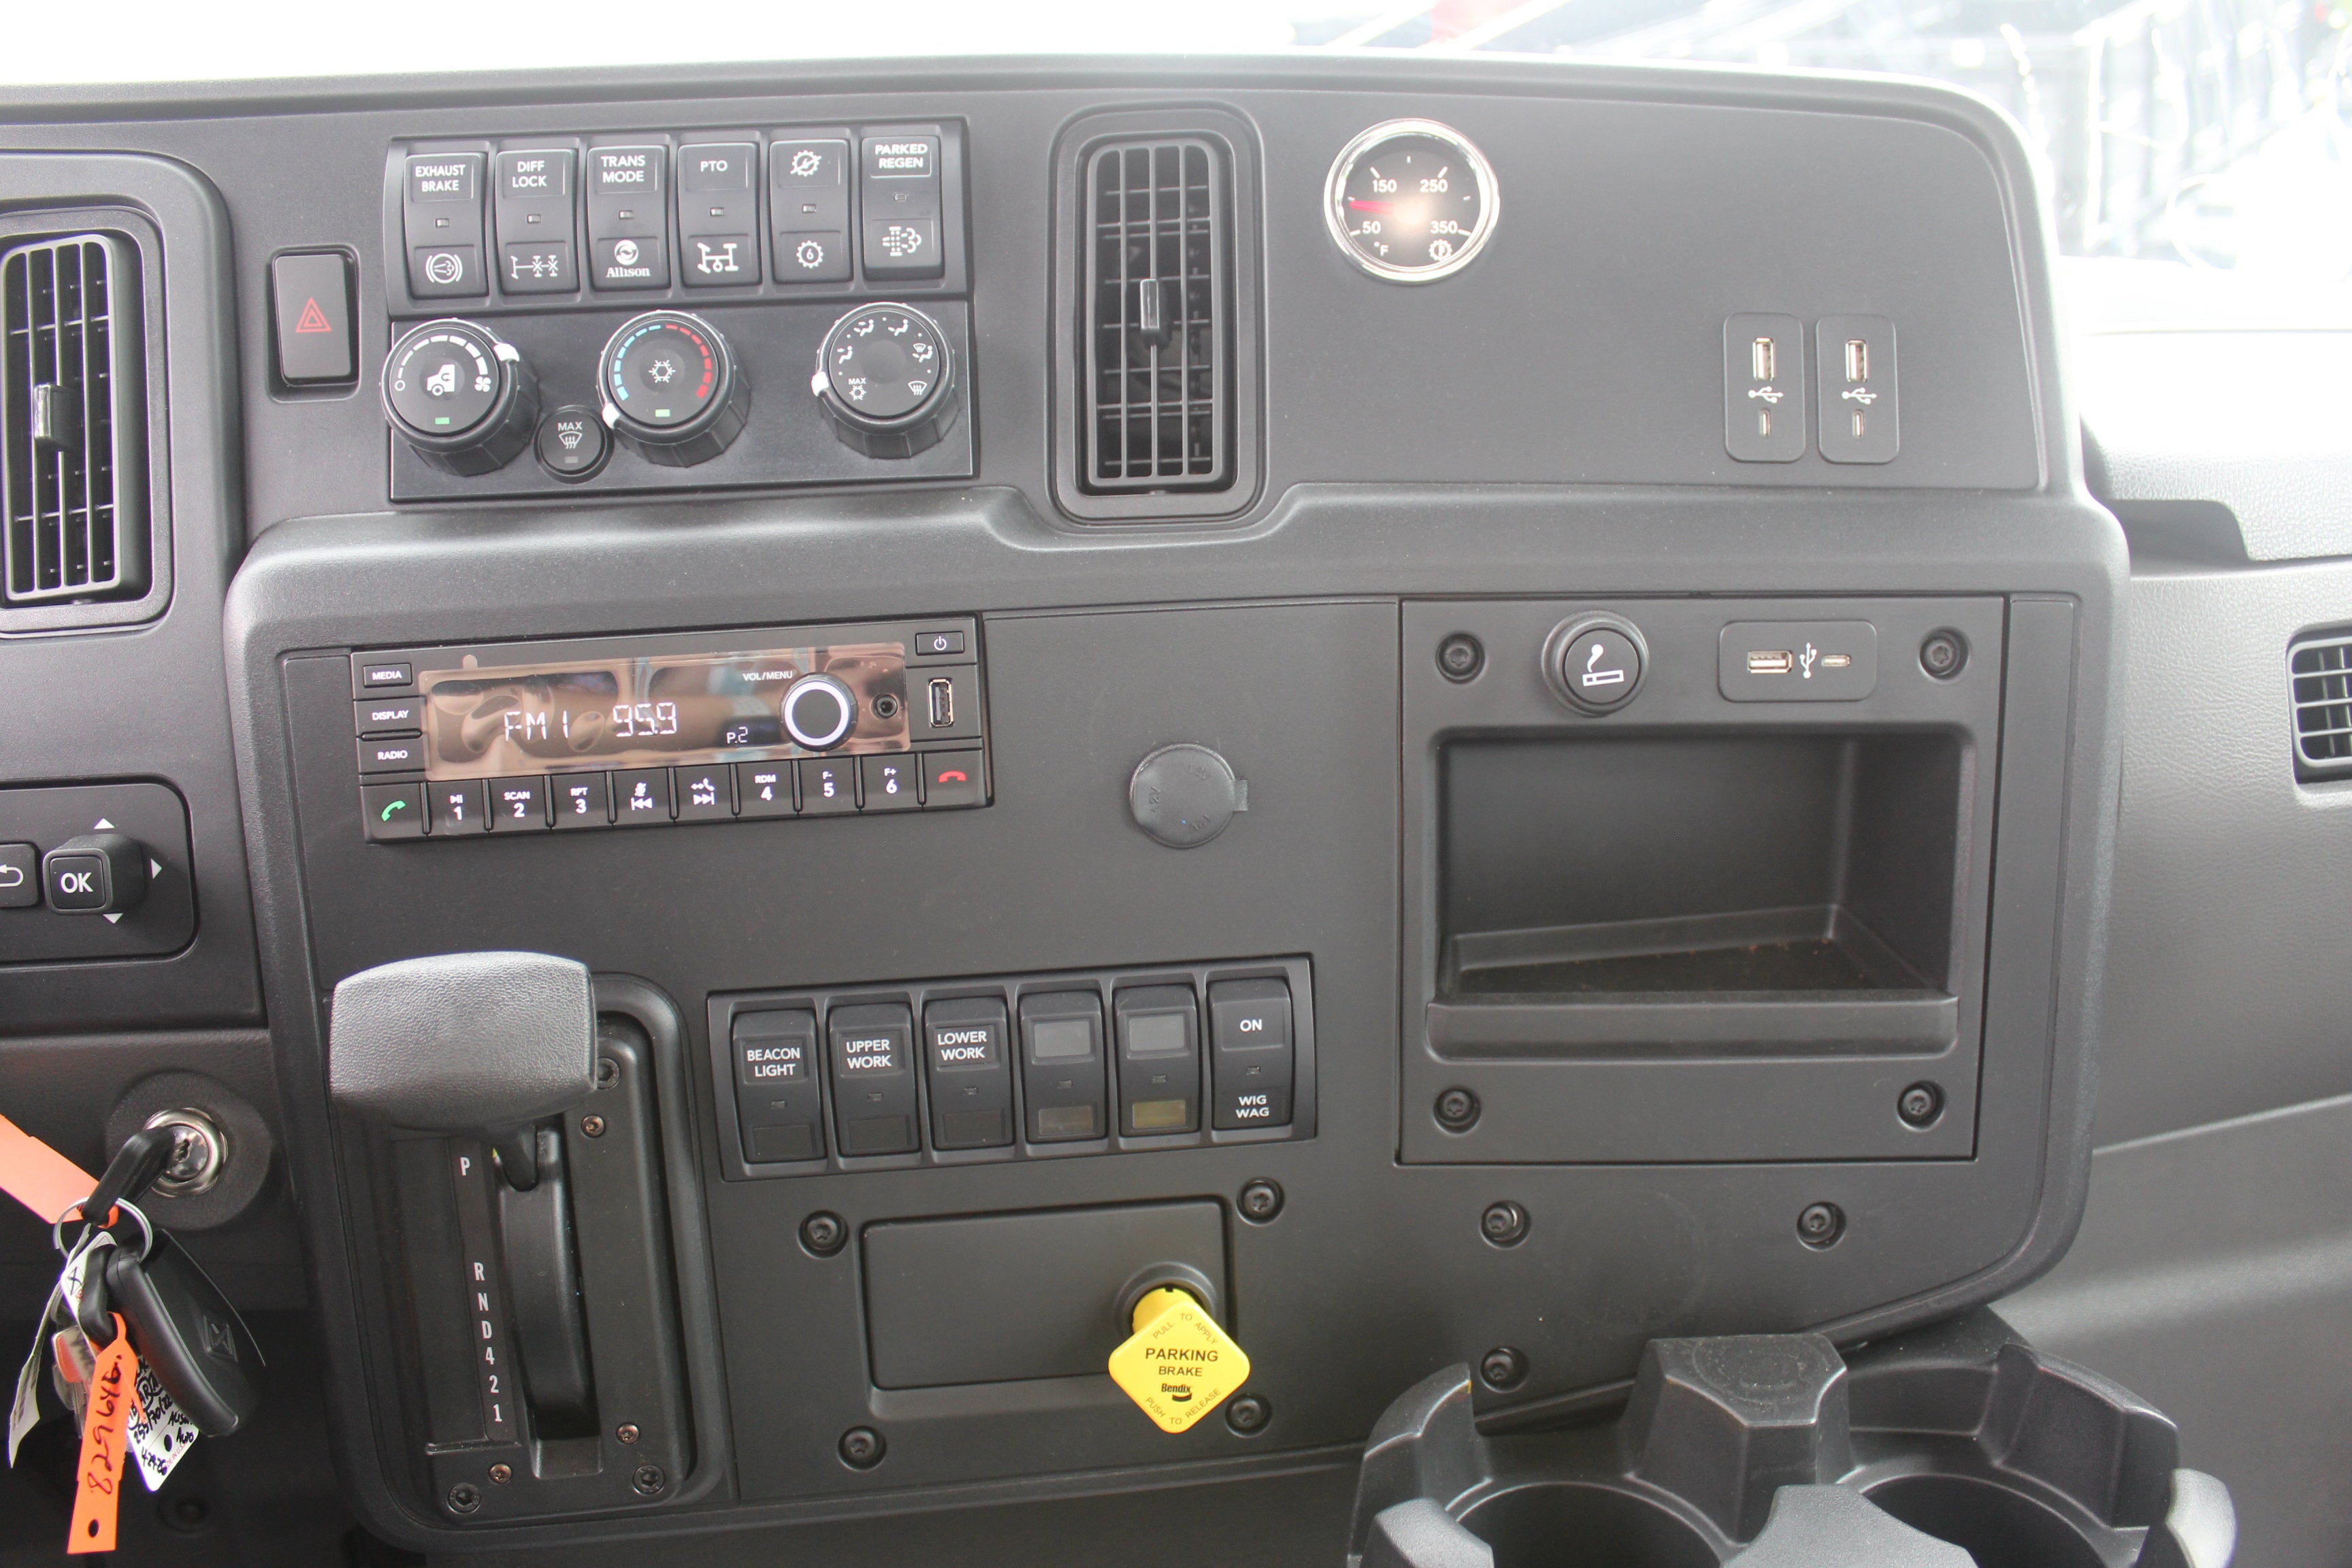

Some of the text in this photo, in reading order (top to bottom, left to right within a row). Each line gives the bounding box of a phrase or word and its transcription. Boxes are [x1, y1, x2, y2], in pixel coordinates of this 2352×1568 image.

[875, 144, 928, 155] PARKED
[517, 160, 544, 173] DIFF
[601, 155, 646, 167] TRANS
[700, 160, 728, 172] PTO
[879, 157, 924, 169] REGEN
[415, 164, 466, 178] EXHAUST
[602, 171, 644, 183] MODE
[421, 180, 459, 193] BRAKE
[512, 175, 547, 188] LOCK
[1373, 180, 1396, 193] 150
[1420, 179, 1448, 192] 250
[1362, 220, 1382, 234] 50
[1430, 220, 1458, 234] 350
[606, 267, 651, 278] Allison
[848, 377, 866, 386] MAX
[557, 421, 583, 432] MAX
[372, 670, 403, 681] MEDIA
[742, 670, 794, 681] VOL/MENU
[372, 709, 409, 721] DISPLAY
[377, 749, 408, 760] RADIO
[754, 774, 777, 784] RDM
[884, 768, 896, 777] F+
[570, 787, 588, 796] RPT
[823, 782, 834, 798] 5
[885, 779, 898, 794] 6
[504, 791, 531, 800] SCAN
[760, 786, 773, 801] 4
[513, 802, 525, 818] 2
[575, 799, 587, 814] 3
[453, 806, 463, 821] 1
[60, 872, 94, 894] OK
[1239, 1019, 1262, 1031] ON
[937, 1030, 987, 1045] LOWER
[846, 1039, 891, 1054] UPPER
[747, 1047, 800, 1062] BEACON
[941, 1046, 985, 1061] WORK
[847, 1055, 892, 1069] WORK
[754, 1064, 796, 1077] LIGHT
[1238, 1094, 1267, 1106] WIG
[1235, 1107, 1269, 1119] WAG
[460, 1157, 502, 1422] P R N D 4 2 1
[1152, 1322, 1175, 1339] PULL
[1194, 1322, 1218, 1345] APPLY
[1145, 1348, 1219, 1362] PARKING
[1158, 1367, 1203, 1377] BRAKE
[1161, 1383, 1191, 1394] Bendix
[1145, 1397, 1166, 1418] PUSH
[1185, 1388, 1222, 1418] RELEASE
